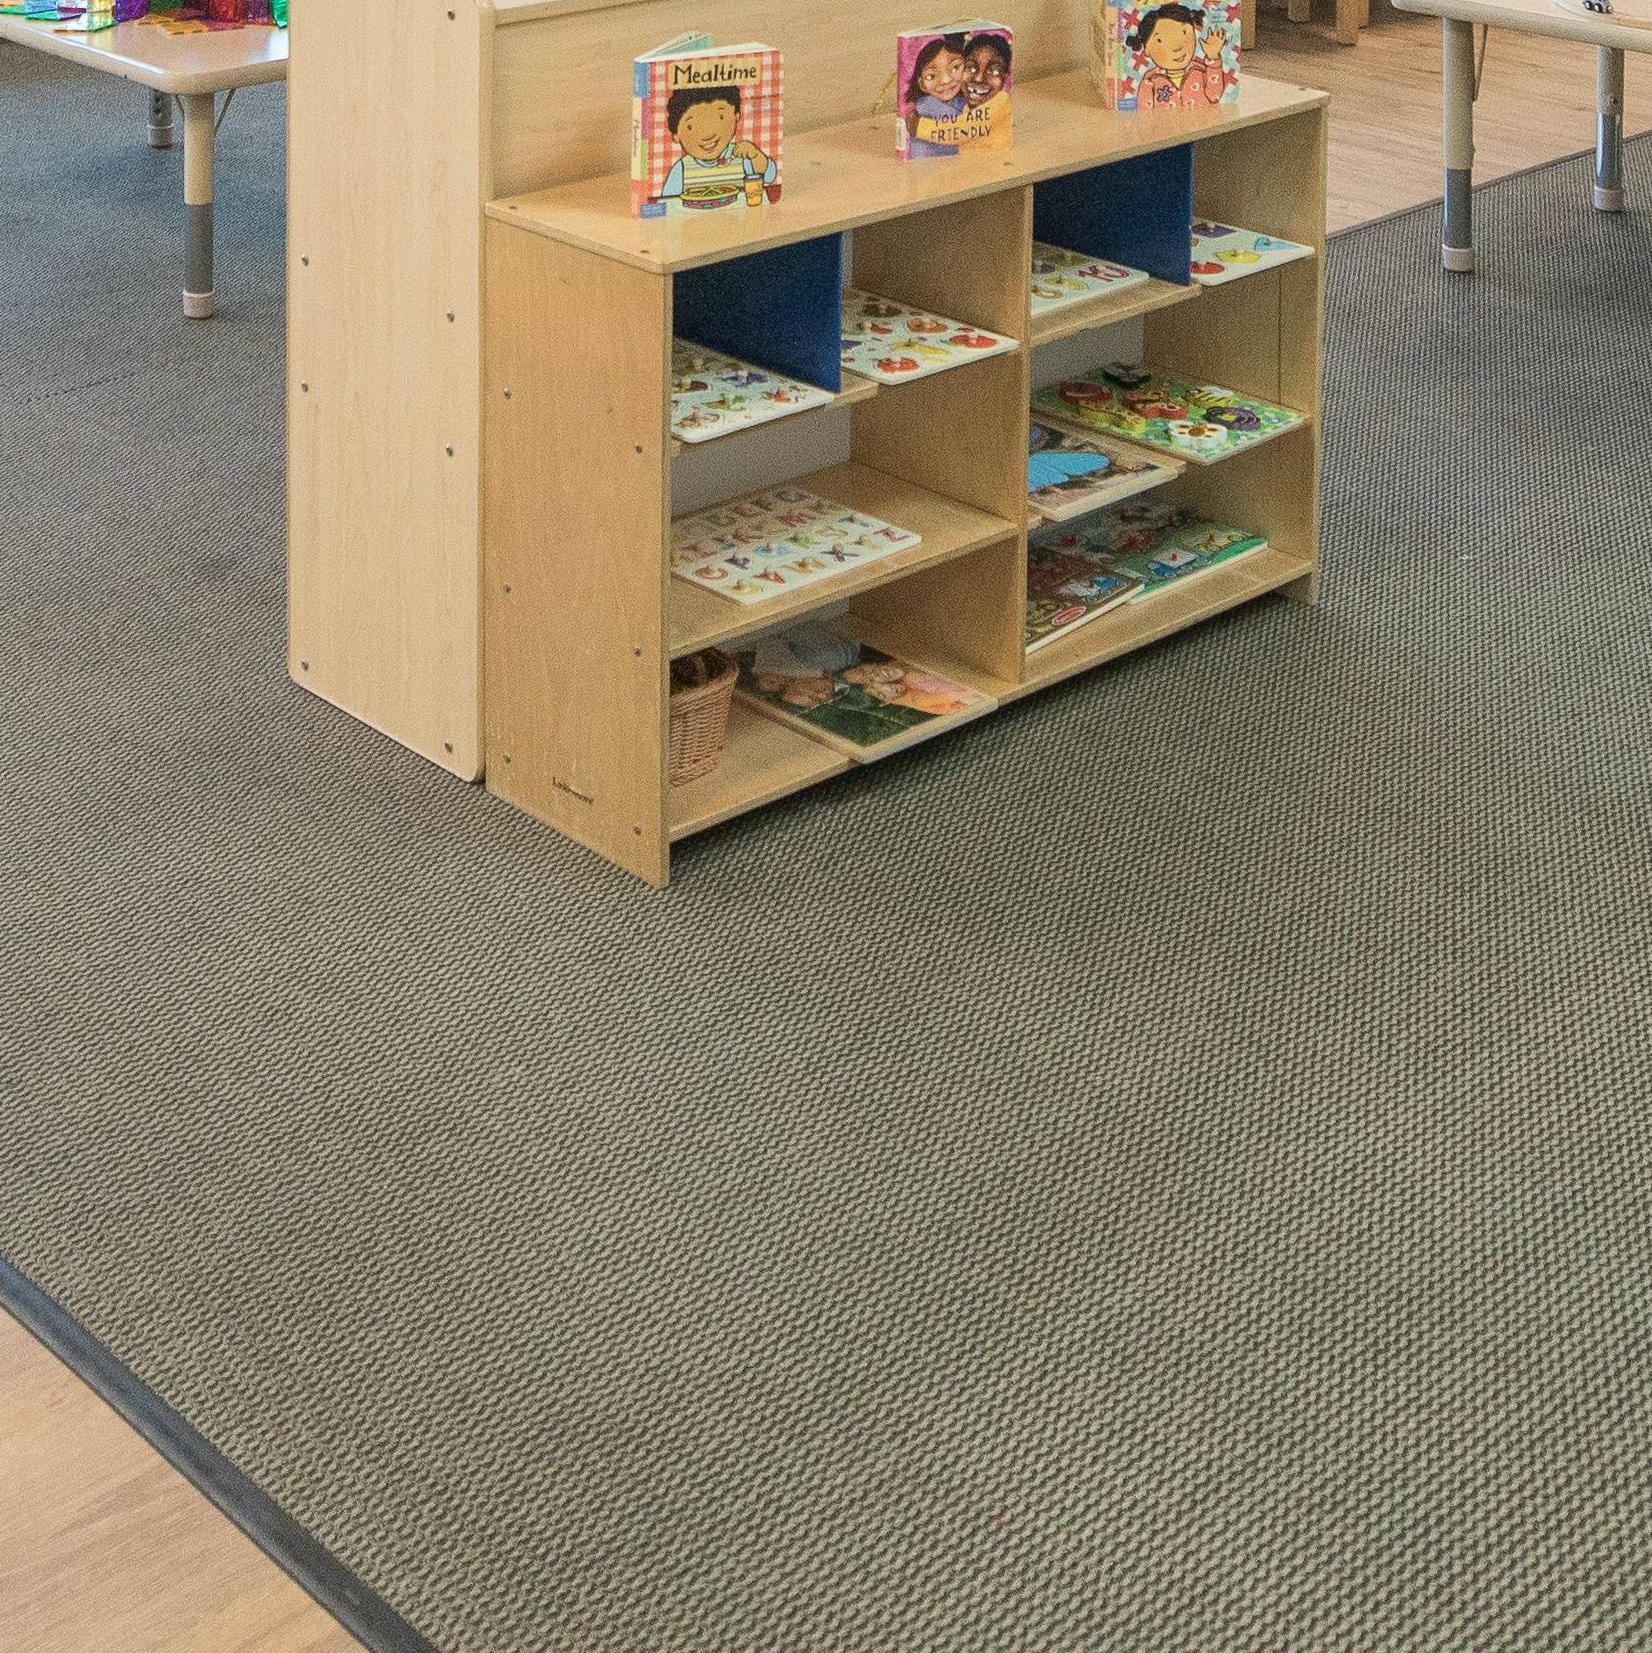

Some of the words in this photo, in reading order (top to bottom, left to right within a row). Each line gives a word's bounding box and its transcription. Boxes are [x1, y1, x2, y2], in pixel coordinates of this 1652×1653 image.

[672, 63, 758, 86] Mealtime
[933, 111, 959, 126] YOU
[965, 107, 991, 123] ARE
[930, 122, 995, 143] FRIENDLY
